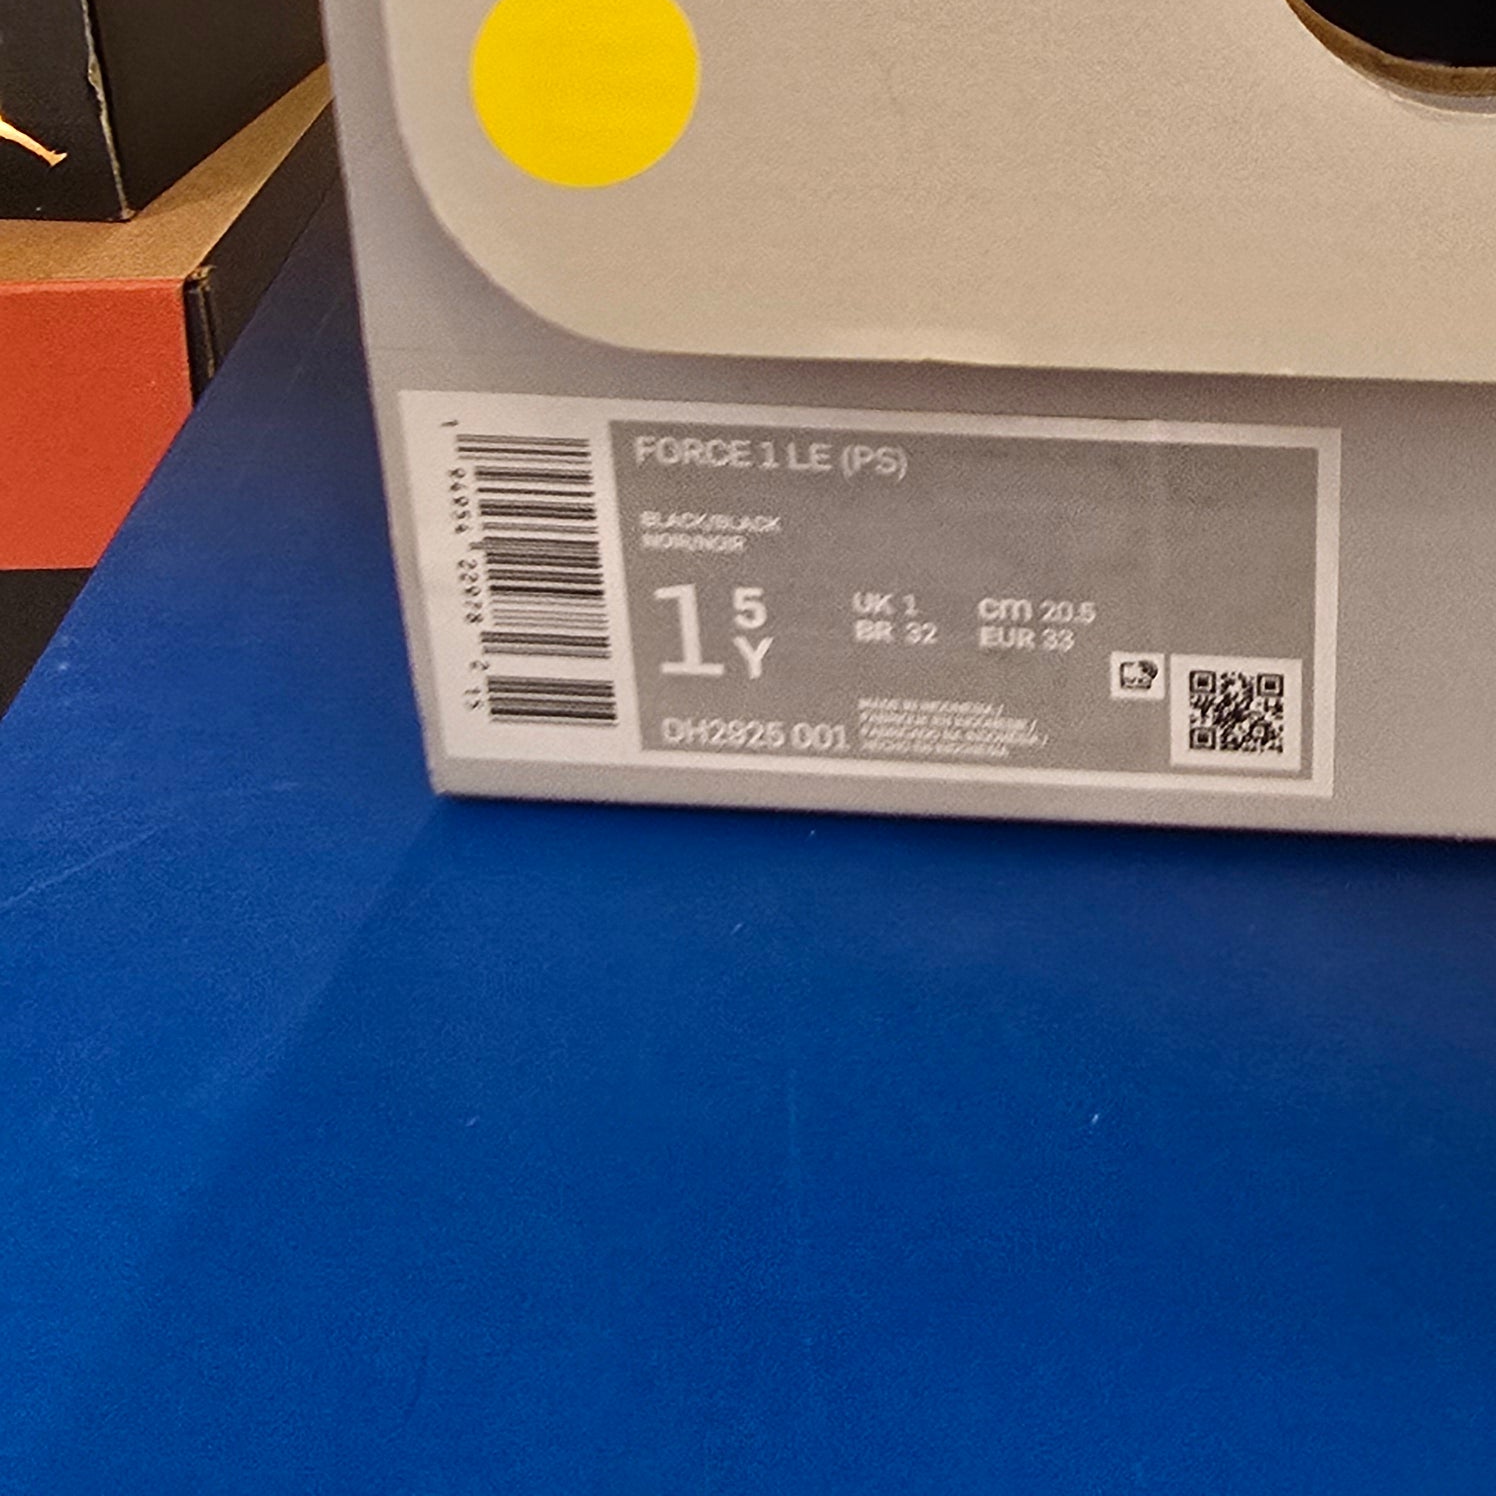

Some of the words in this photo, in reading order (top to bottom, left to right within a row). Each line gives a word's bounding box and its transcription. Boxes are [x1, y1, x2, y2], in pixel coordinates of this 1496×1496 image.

[633, 436, 753, 469] FORCE
[758, 440, 780, 469] 1
[786, 441, 833, 471] LE
[841, 444, 908, 484] (PS)
[732, 586, 768, 630] 5
[852, 591, 895, 616] UK
[902, 593, 921, 618] 1
[977, 596, 1034, 623] cm
[1038, 599, 1097, 625] 20.5
[653, 583, 725, 676] 1
[854, 618, 895, 643] BR
[904, 621, 938, 646] 32
[978, 625, 1036, 651] EUR
[1040, 627, 1076, 653] 33
[731, 635, 775, 679] Y
[789, 721, 850, 752] 001
